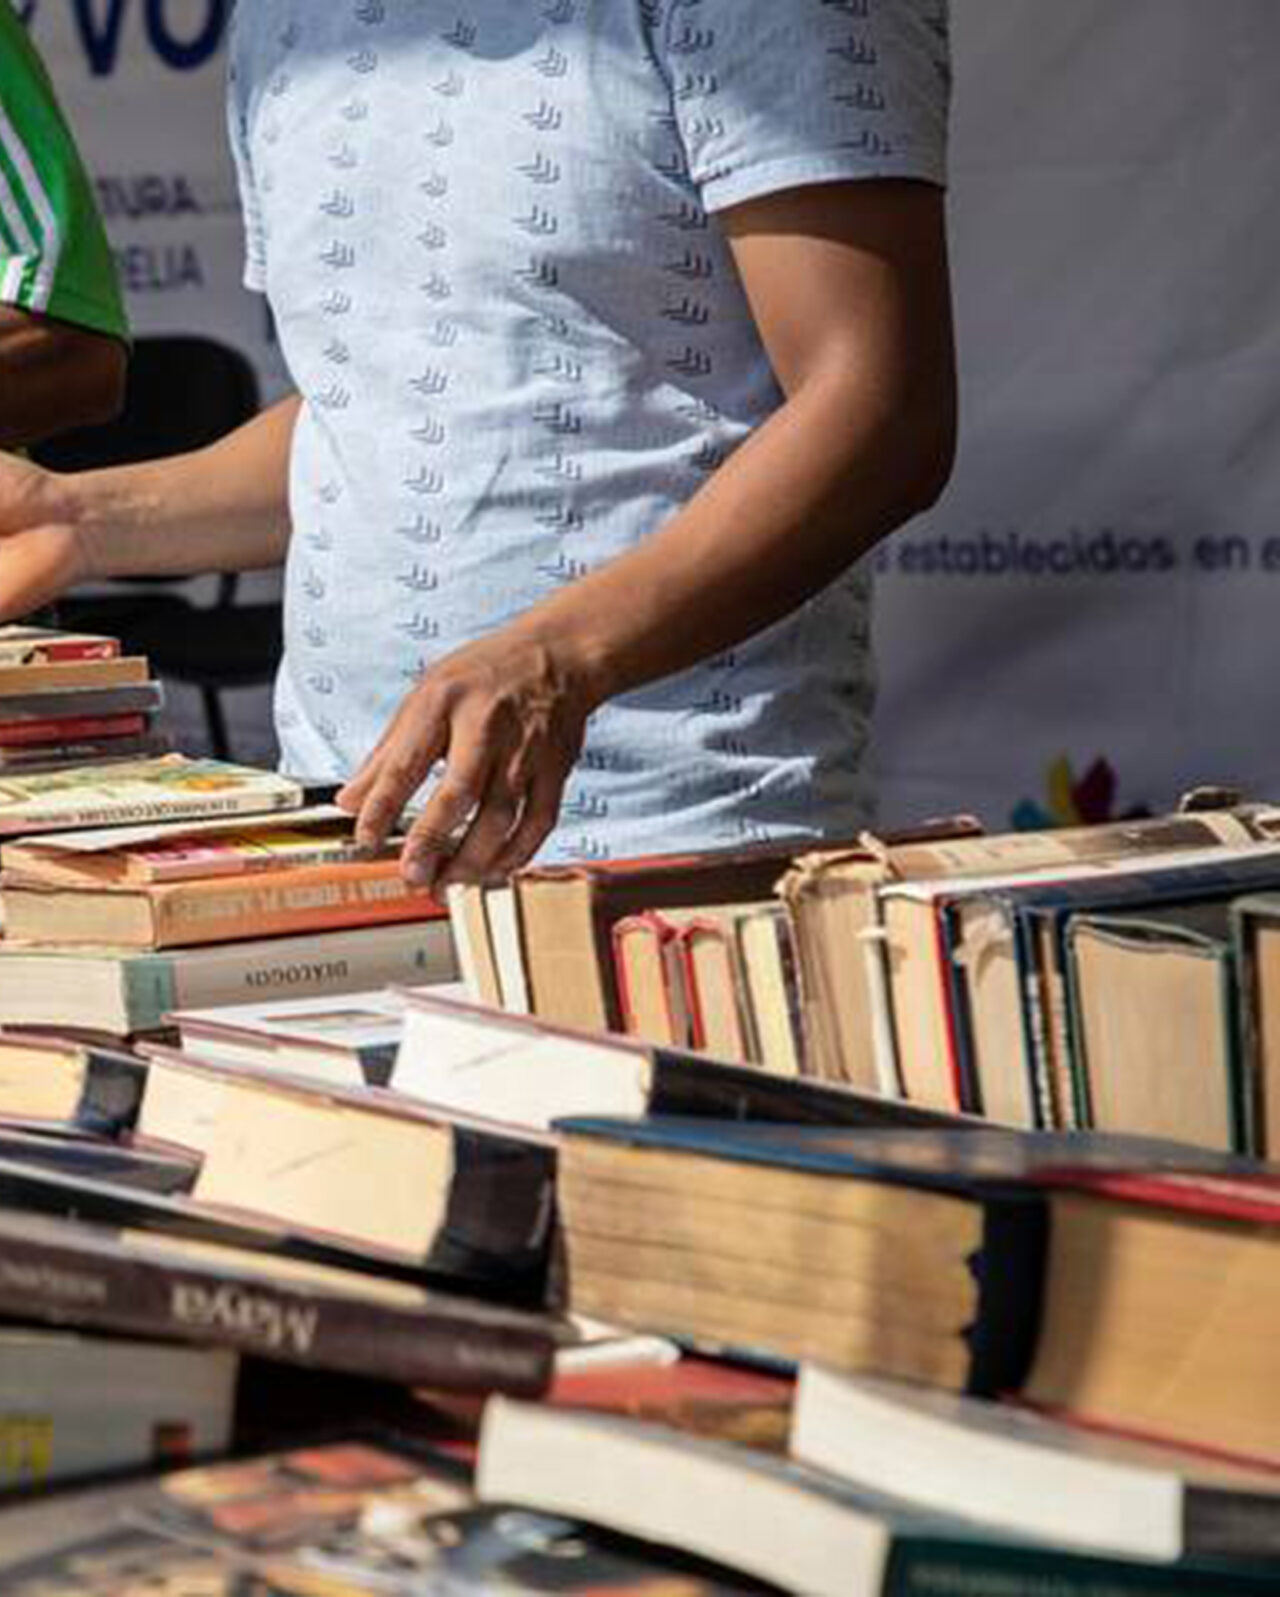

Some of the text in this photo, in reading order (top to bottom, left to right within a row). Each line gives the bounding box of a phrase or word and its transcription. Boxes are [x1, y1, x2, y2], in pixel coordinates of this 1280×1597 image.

[119, 244, 204, 293] ELIA
[898, 526, 1177, 575] establecidos
[1193, 533, 1250, 571] en
[170, 1281, 320, 1354] Maya
